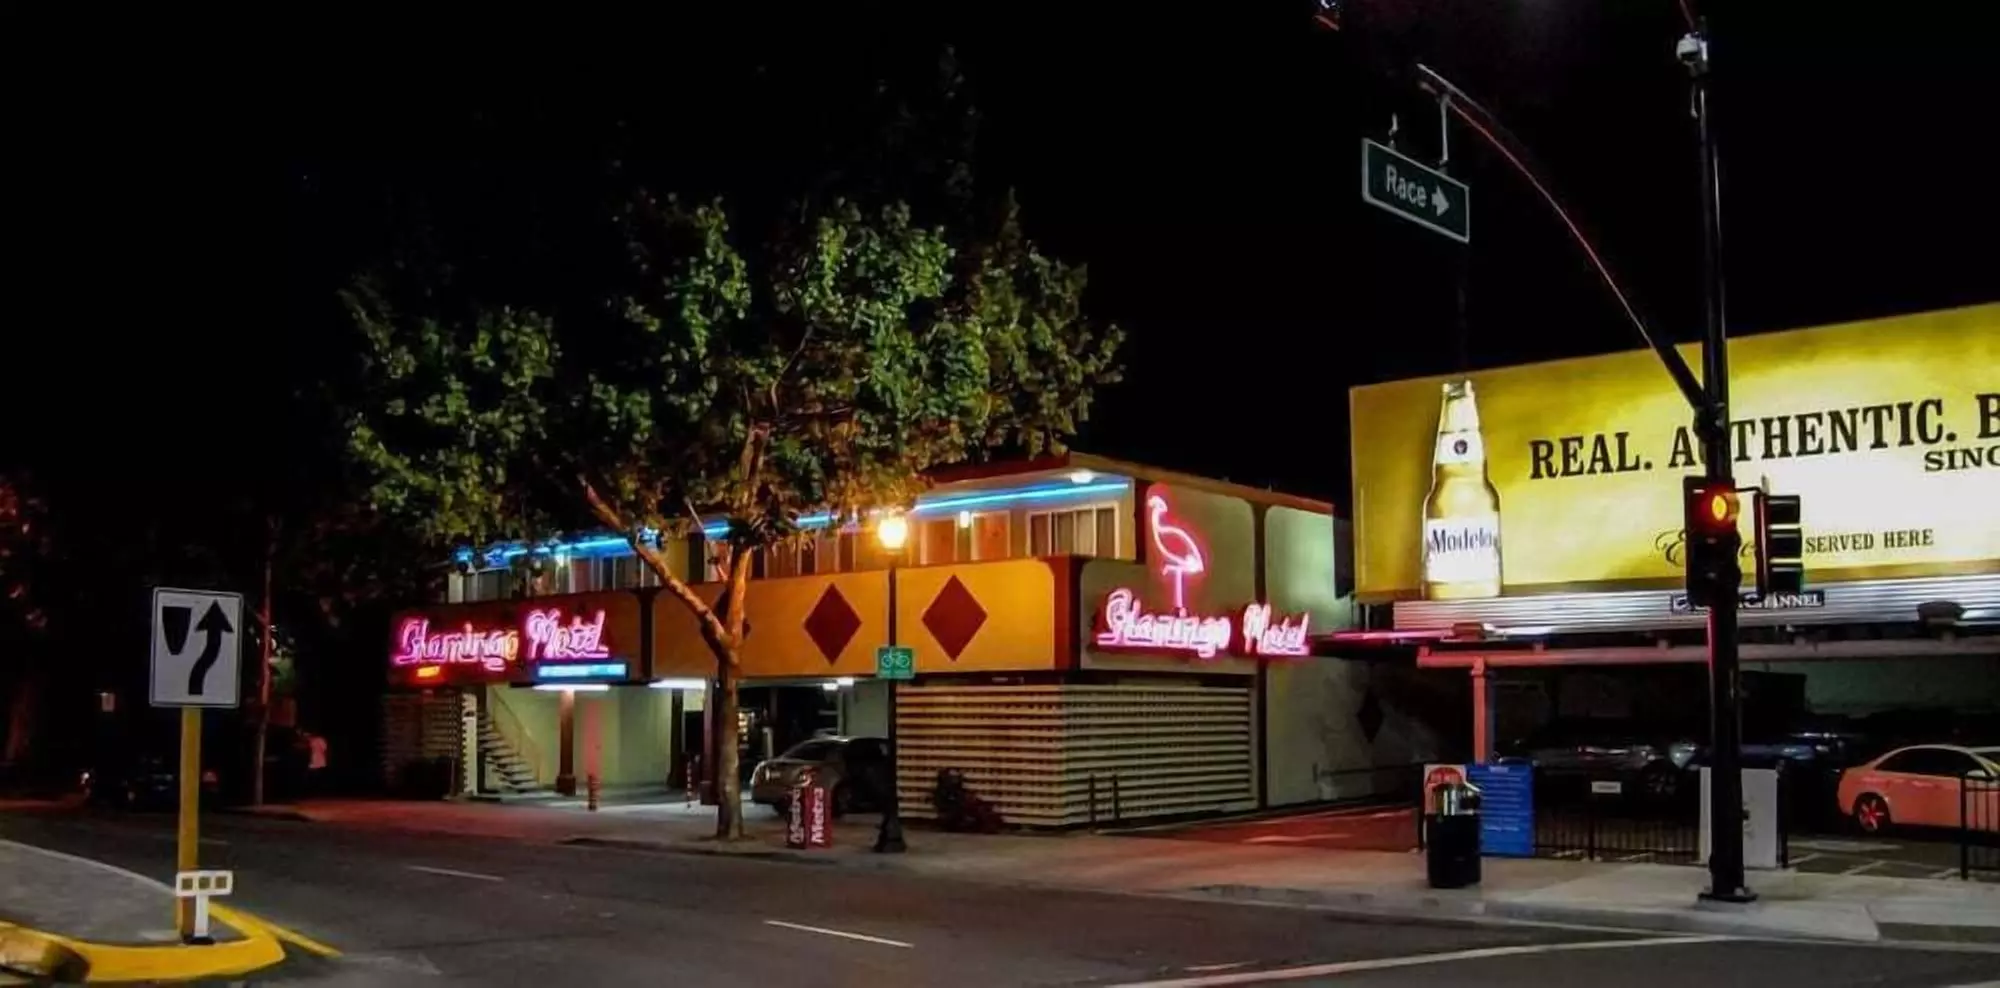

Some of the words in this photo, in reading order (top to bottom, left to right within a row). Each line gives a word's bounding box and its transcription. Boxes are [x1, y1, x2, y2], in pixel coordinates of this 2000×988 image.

[1386, 164, 1427, 208] Race
[1529, 431, 1653, 479] REAL.
[1668, 398, 1957, 468] ATHENTIC.
[1427, 527, 1494, 554] Modelo
[1805, 532, 1874, 553] SERVED
[1883, 528, 1934, 549] HERE
[394, 617, 519, 671] Flamingo
[527, 608, 609, 660] Motel
[1097, 588, 1231, 658] Flamingo
[1243, 602, 1309, 656] Motel
